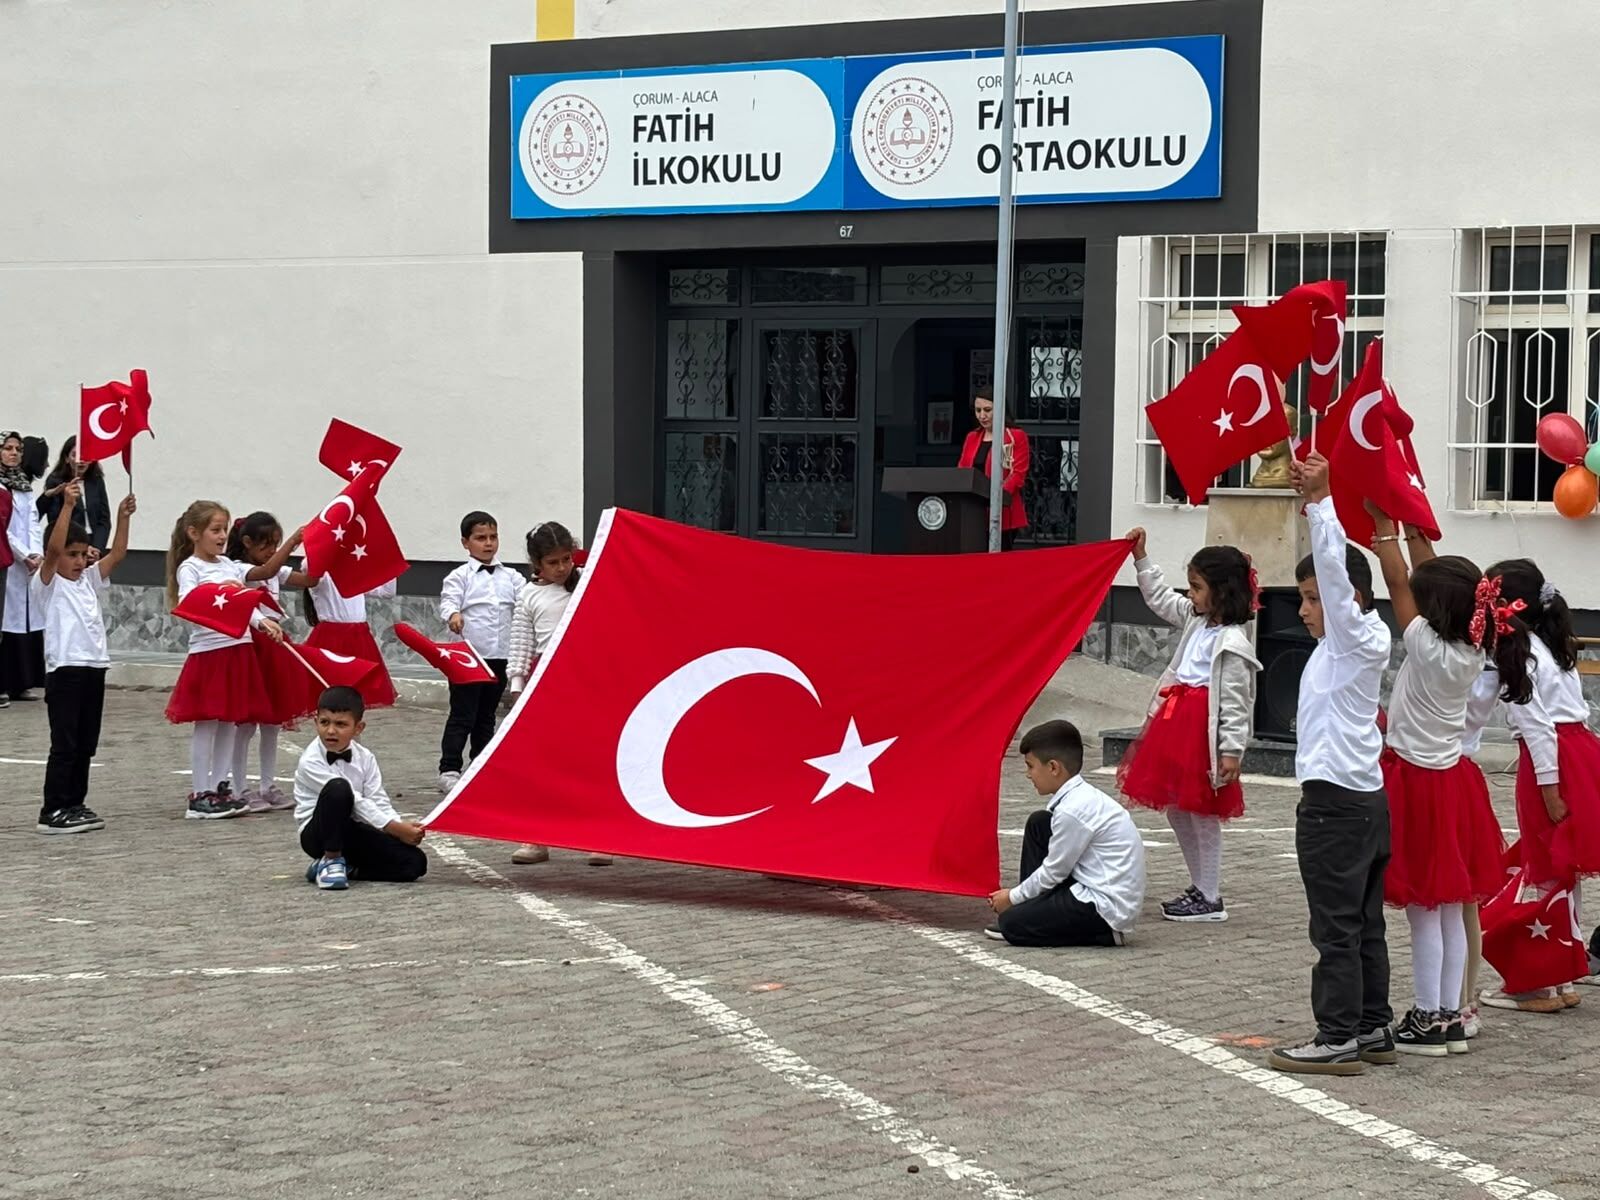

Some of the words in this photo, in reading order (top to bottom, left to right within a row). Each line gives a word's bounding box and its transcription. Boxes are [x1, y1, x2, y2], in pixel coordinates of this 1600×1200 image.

[977, 74, 1022, 92] ÇORM
[1033, 71, 1074, 86] ALACA
[633, 92, 673, 108] ÇORUM
[682, 90, 718, 103] ALACA
[633, 107, 714, 143] FATİH
[633, 151, 781, 186] İLKOKULU
[839, 225, 852, 238] 67
